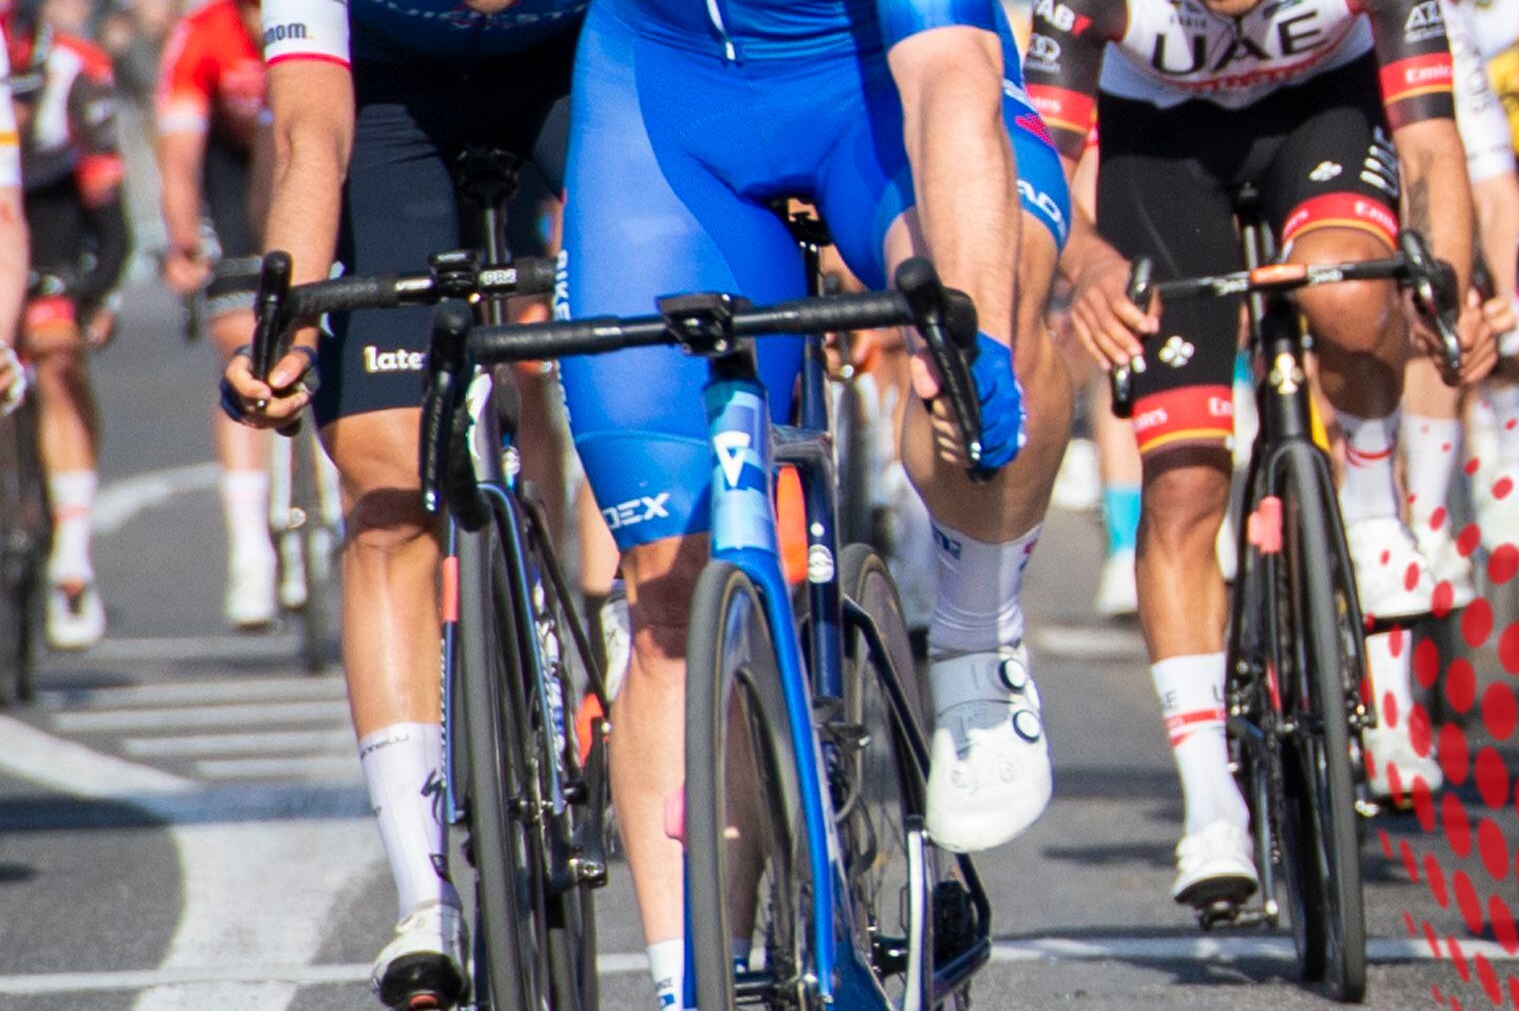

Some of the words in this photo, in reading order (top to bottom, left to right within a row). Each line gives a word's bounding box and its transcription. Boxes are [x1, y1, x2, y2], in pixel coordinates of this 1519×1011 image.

[1152, 9, 1329, 77] UAE
[364, 346, 425, 373] late
[608, 492, 670, 530] DEX
